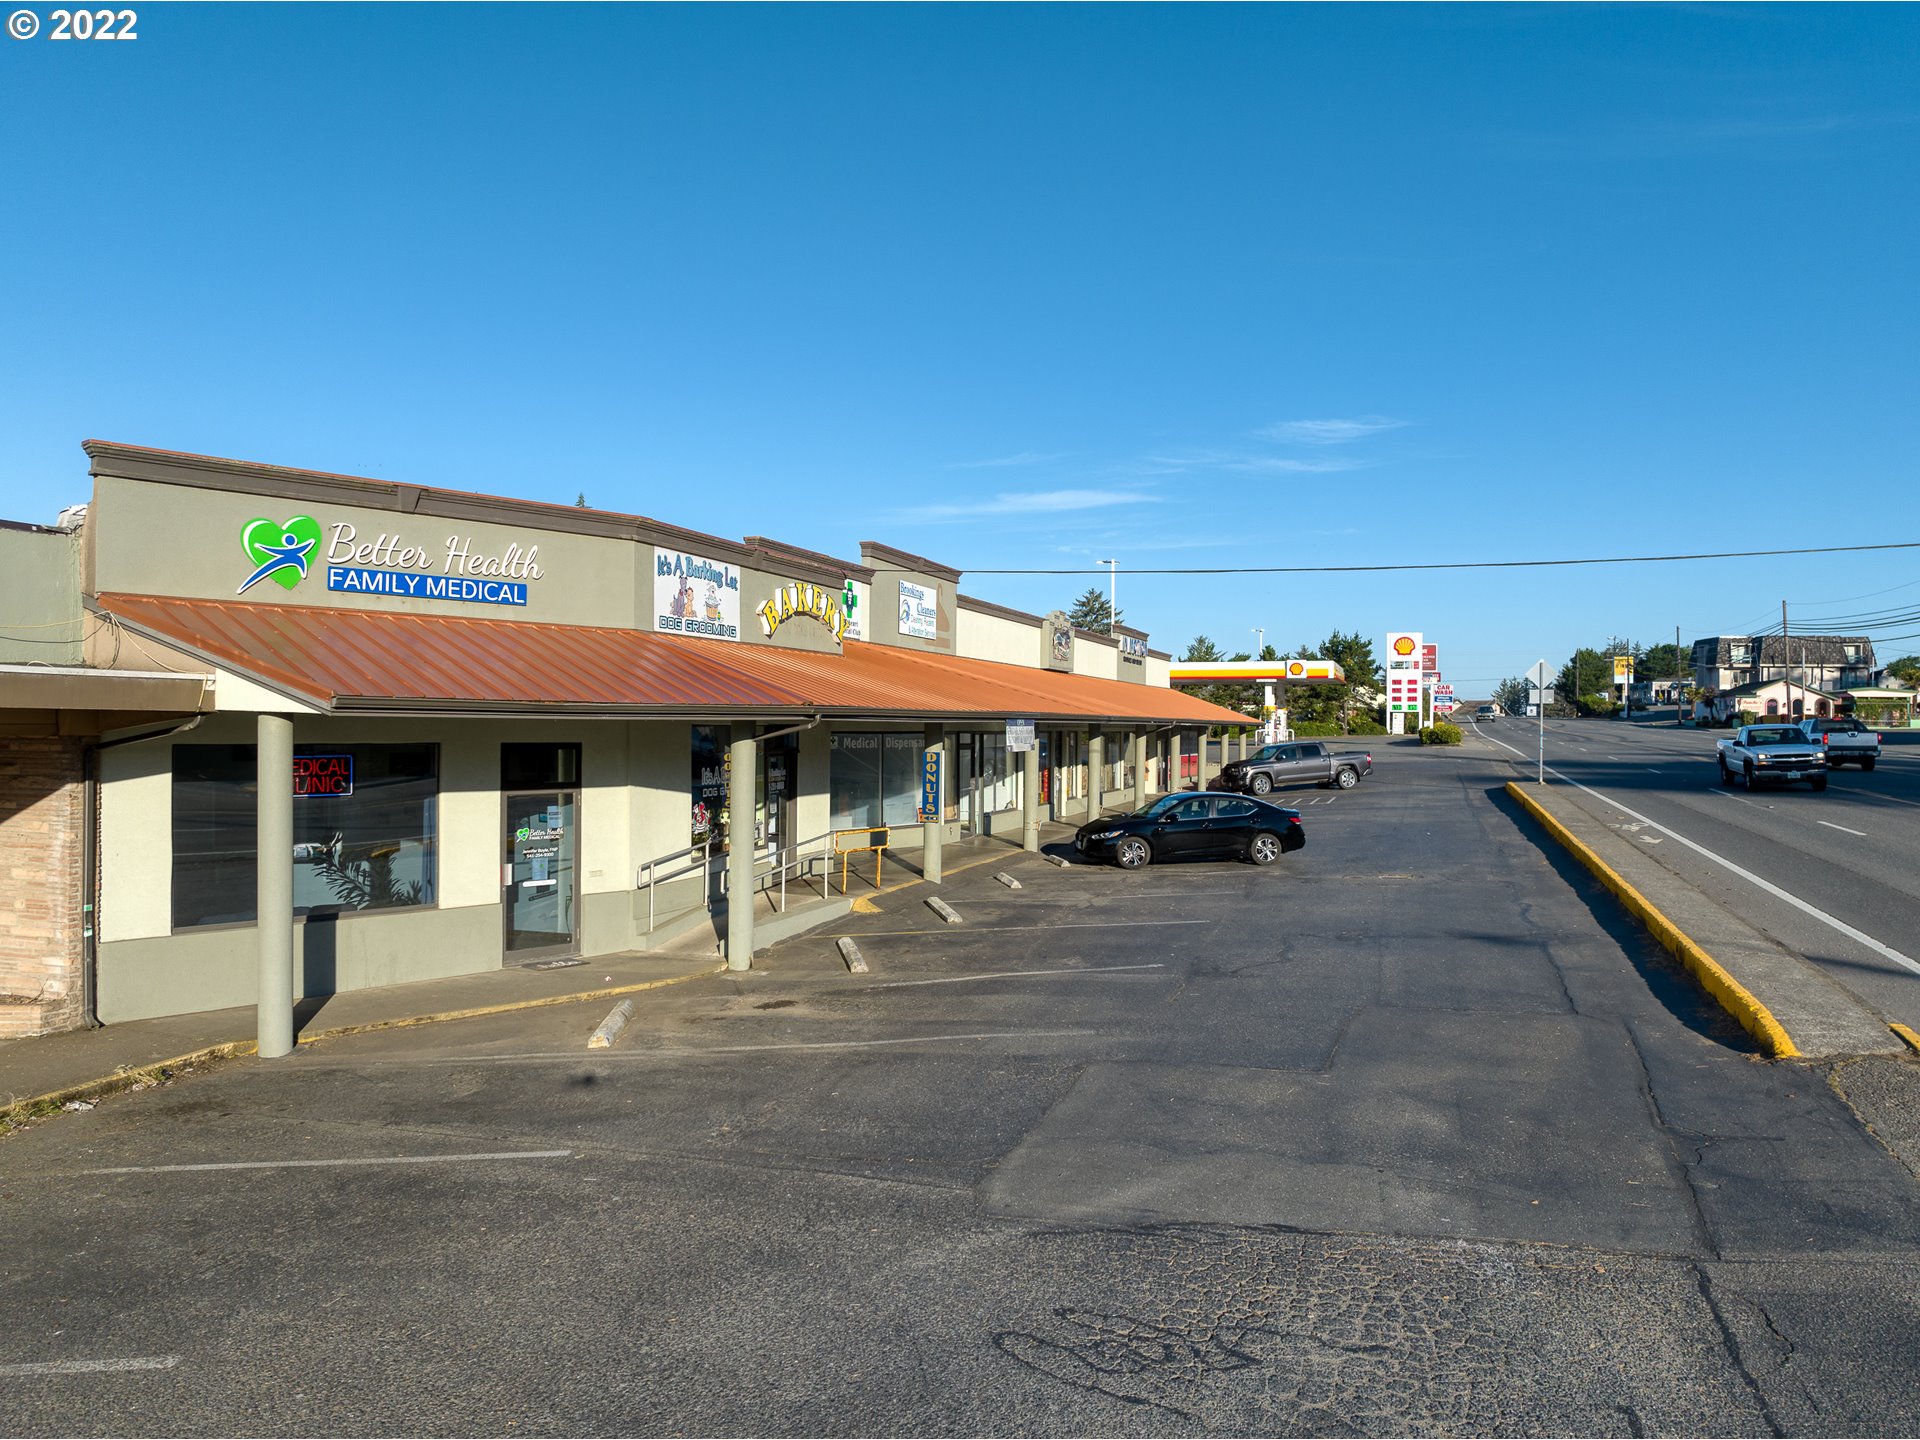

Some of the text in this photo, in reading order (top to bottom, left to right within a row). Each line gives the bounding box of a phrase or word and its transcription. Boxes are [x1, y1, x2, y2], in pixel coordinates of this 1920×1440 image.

[326, 522, 545, 580] Better Health
[657, 554, 672, 576] It's
[673, 553, 685, 576] A
[685, 556, 724, 588] Barking
[329, 568, 526, 604] FAMILY MEDICAL
[900, 582, 925, 601] Brookings
[757, 582, 850, 645] BAKERY
[916, 602, 937, 617] Cleaners
[659, 615, 737, 638] DOG GROOMING
[843, 736, 925, 750] Medical Dispensa
[293, 759, 350, 775] EDICAL
[295, 776, 344, 792] LINIC
[702, 787, 718, 797] DOG
[925, 752, 937, 814] DONUTS
